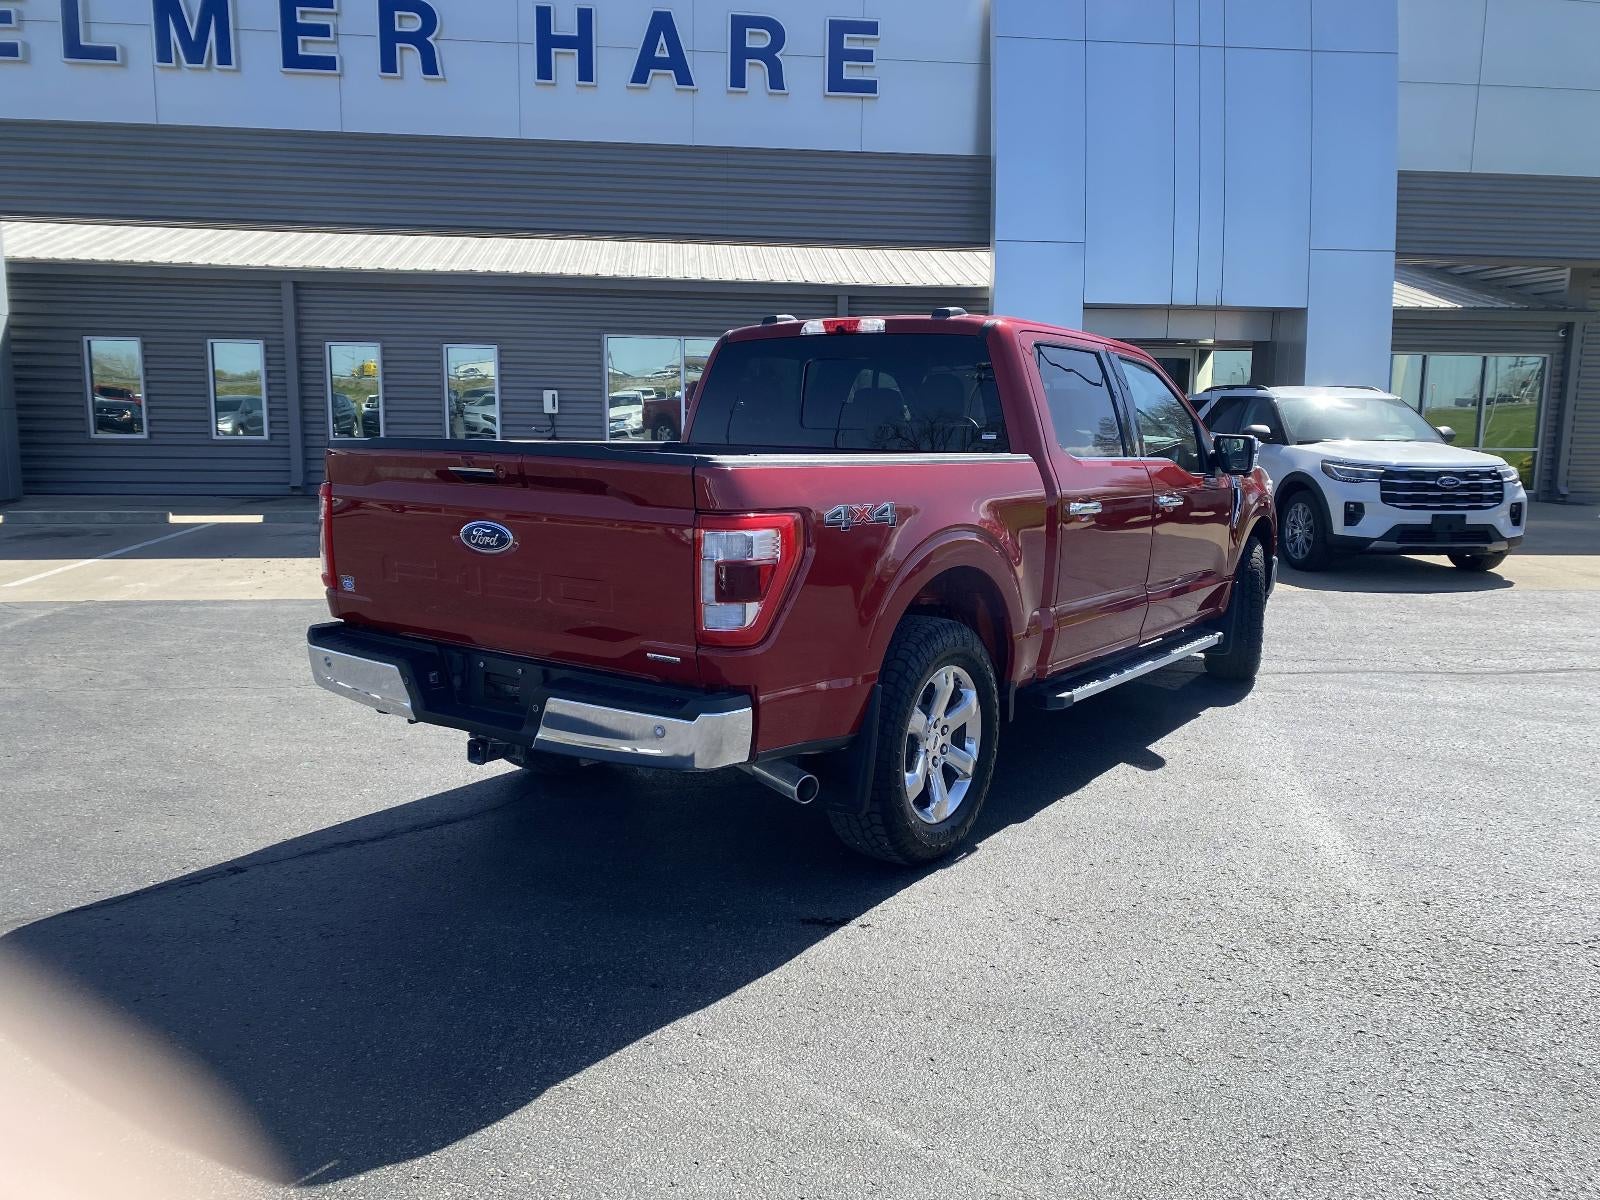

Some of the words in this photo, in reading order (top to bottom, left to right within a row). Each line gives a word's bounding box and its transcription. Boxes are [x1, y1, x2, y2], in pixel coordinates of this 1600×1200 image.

[0, 0, 445, 79] LMER
[535, 5, 880, 97] HARE
[470, 527, 499, 546] Ford
